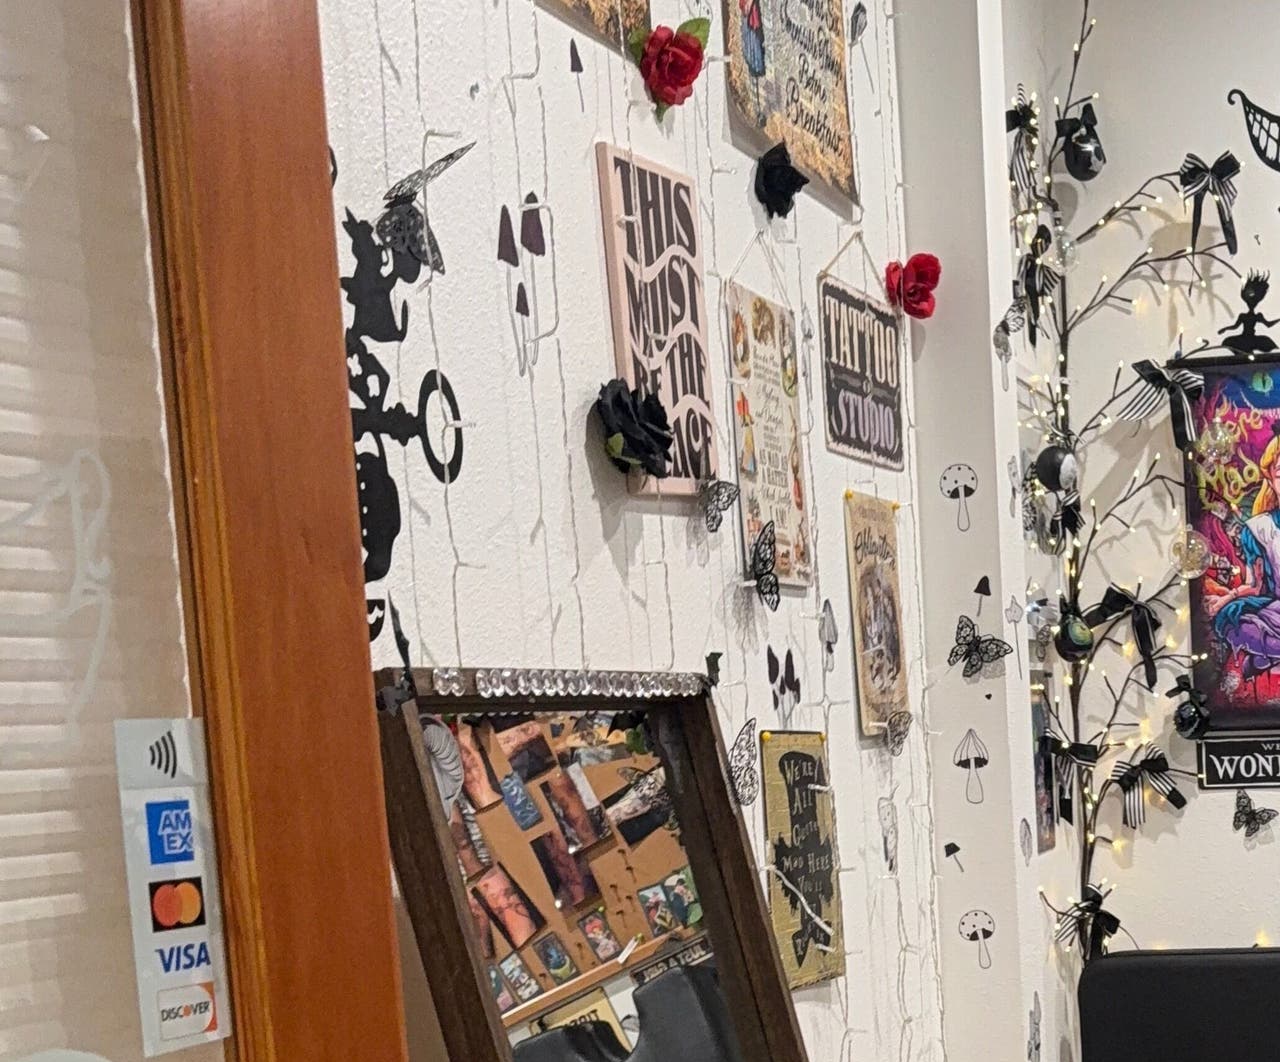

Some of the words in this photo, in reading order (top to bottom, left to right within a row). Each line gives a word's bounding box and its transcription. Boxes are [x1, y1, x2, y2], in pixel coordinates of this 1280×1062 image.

[798, 52, 828, 104] Before
[786, 76, 843, 157] Breakfast
[613, 156, 697, 268] THIS
[623, 254, 702, 359] MUST
[825, 295, 897, 388] TATTOO
[631, 344, 664, 398] BE
[665, 331, 711, 412] THE
[839, 388, 895, 452] STUDIO
[160, 811, 191, 834] AM
[166, 831, 193, 853] EX
[807, 853, 831, 874] HERE
[155, 941, 211, 974] VISA
[161, 999, 210, 1023] DISCOVER
